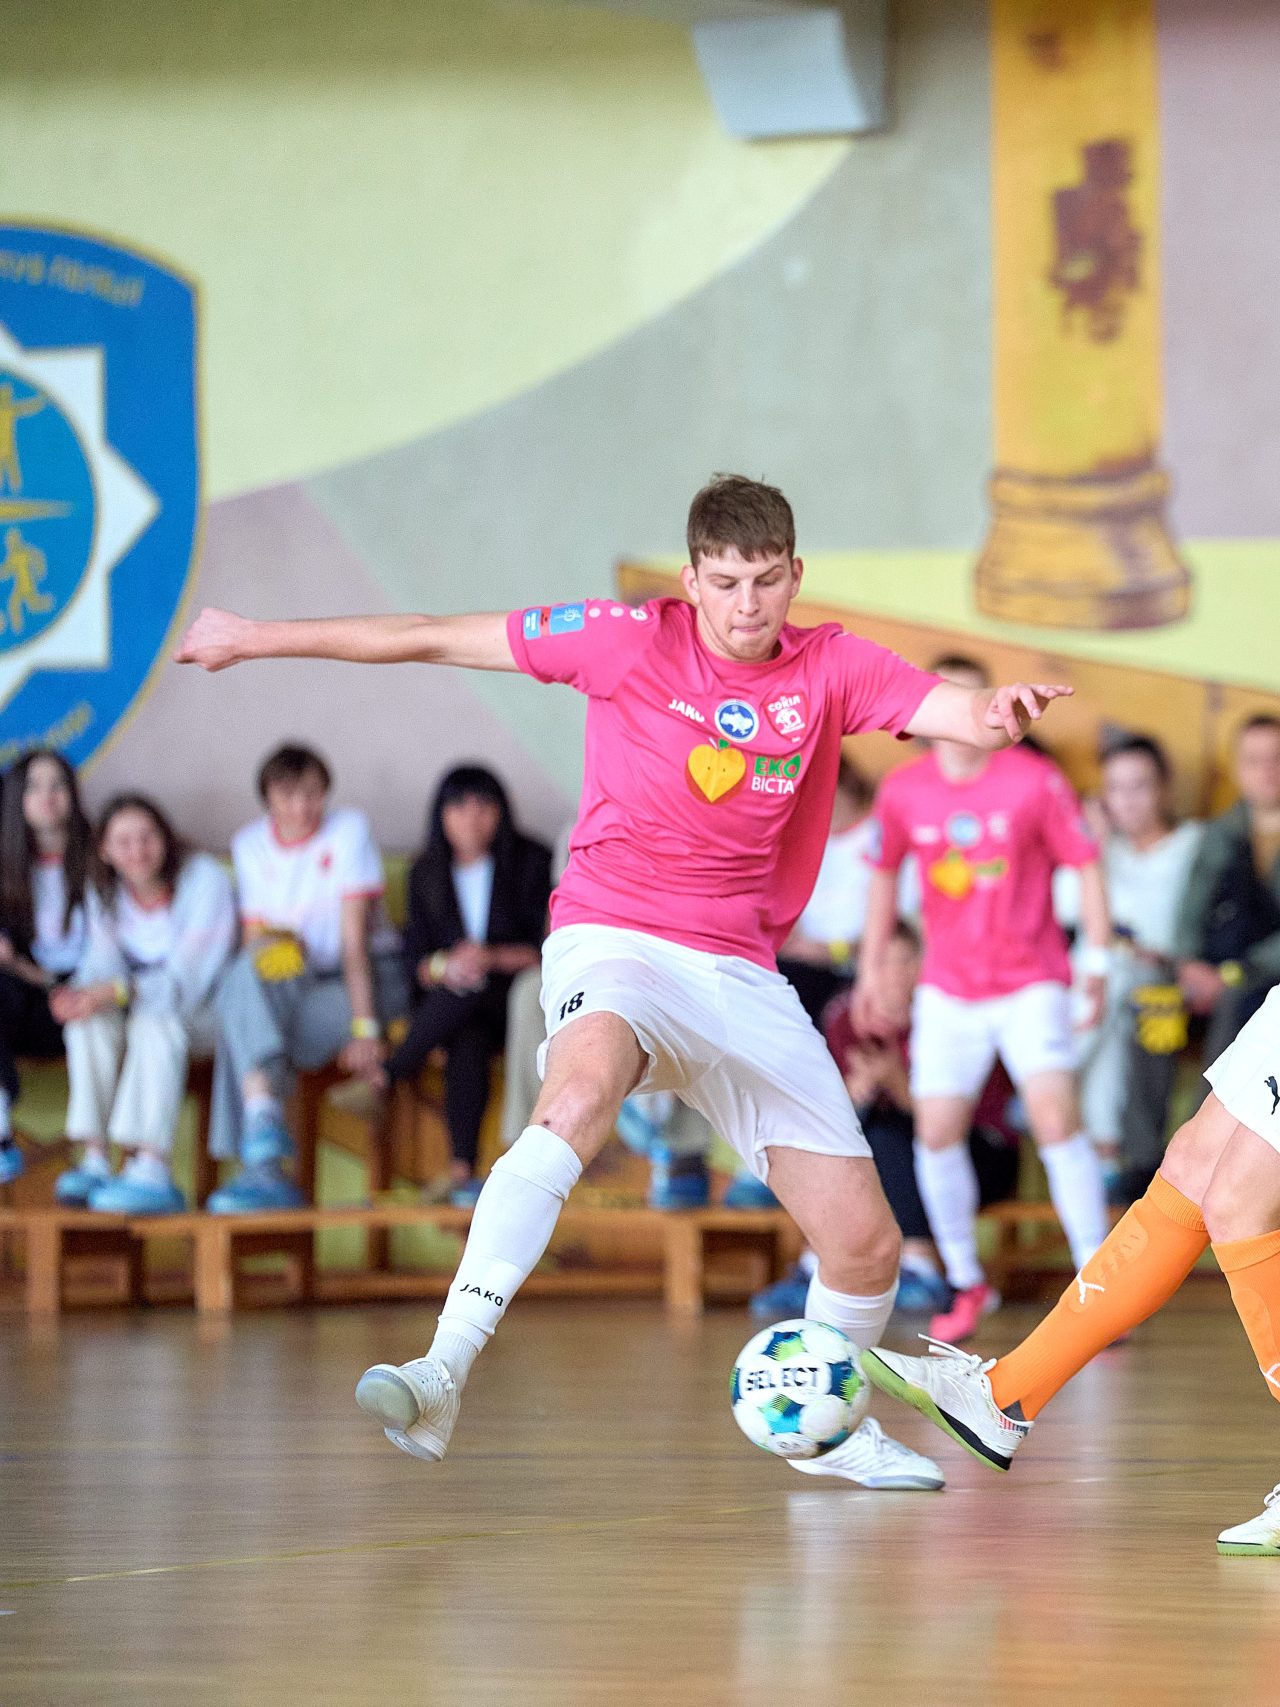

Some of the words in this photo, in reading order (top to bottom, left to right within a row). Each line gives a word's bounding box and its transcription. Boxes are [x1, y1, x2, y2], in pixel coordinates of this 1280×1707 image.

[751, 775, 795, 795] ВІСТА
[559, 991, 585, 1021] 18
[459, 1284, 504, 1307] JAKO
[745, 1367, 819, 1391] SELECT
